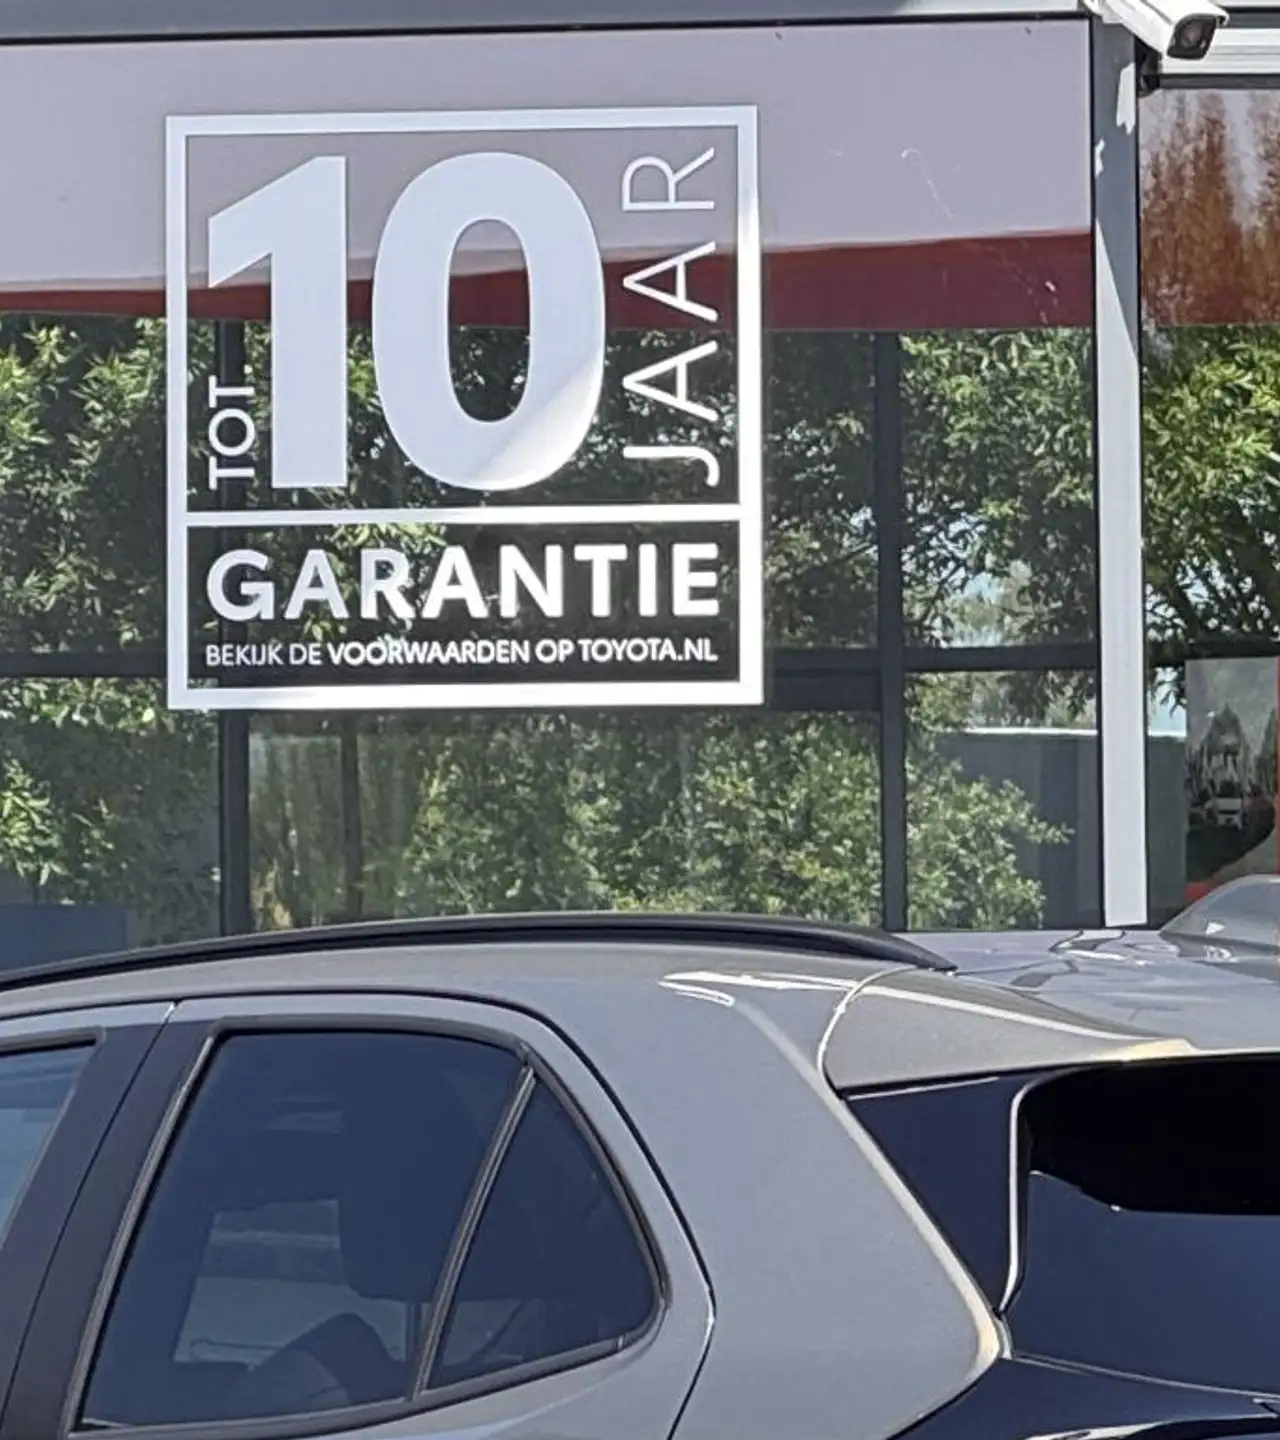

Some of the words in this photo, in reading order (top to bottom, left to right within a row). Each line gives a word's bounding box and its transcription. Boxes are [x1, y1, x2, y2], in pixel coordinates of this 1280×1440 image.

[207, 151, 606, 491] 10
[622, 146, 719, 488] JAAR
[208, 375, 255, 490] TOT
[206, 543, 720, 622] GARANTIE
[206, 643, 283, 666] BEKIJK
[289, 643, 321, 665] DE
[327, 640, 530, 666] VOORWAARDEN
[535, 638, 575, 663] OP
[577, 637, 718, 662] TOYOTA.NL
